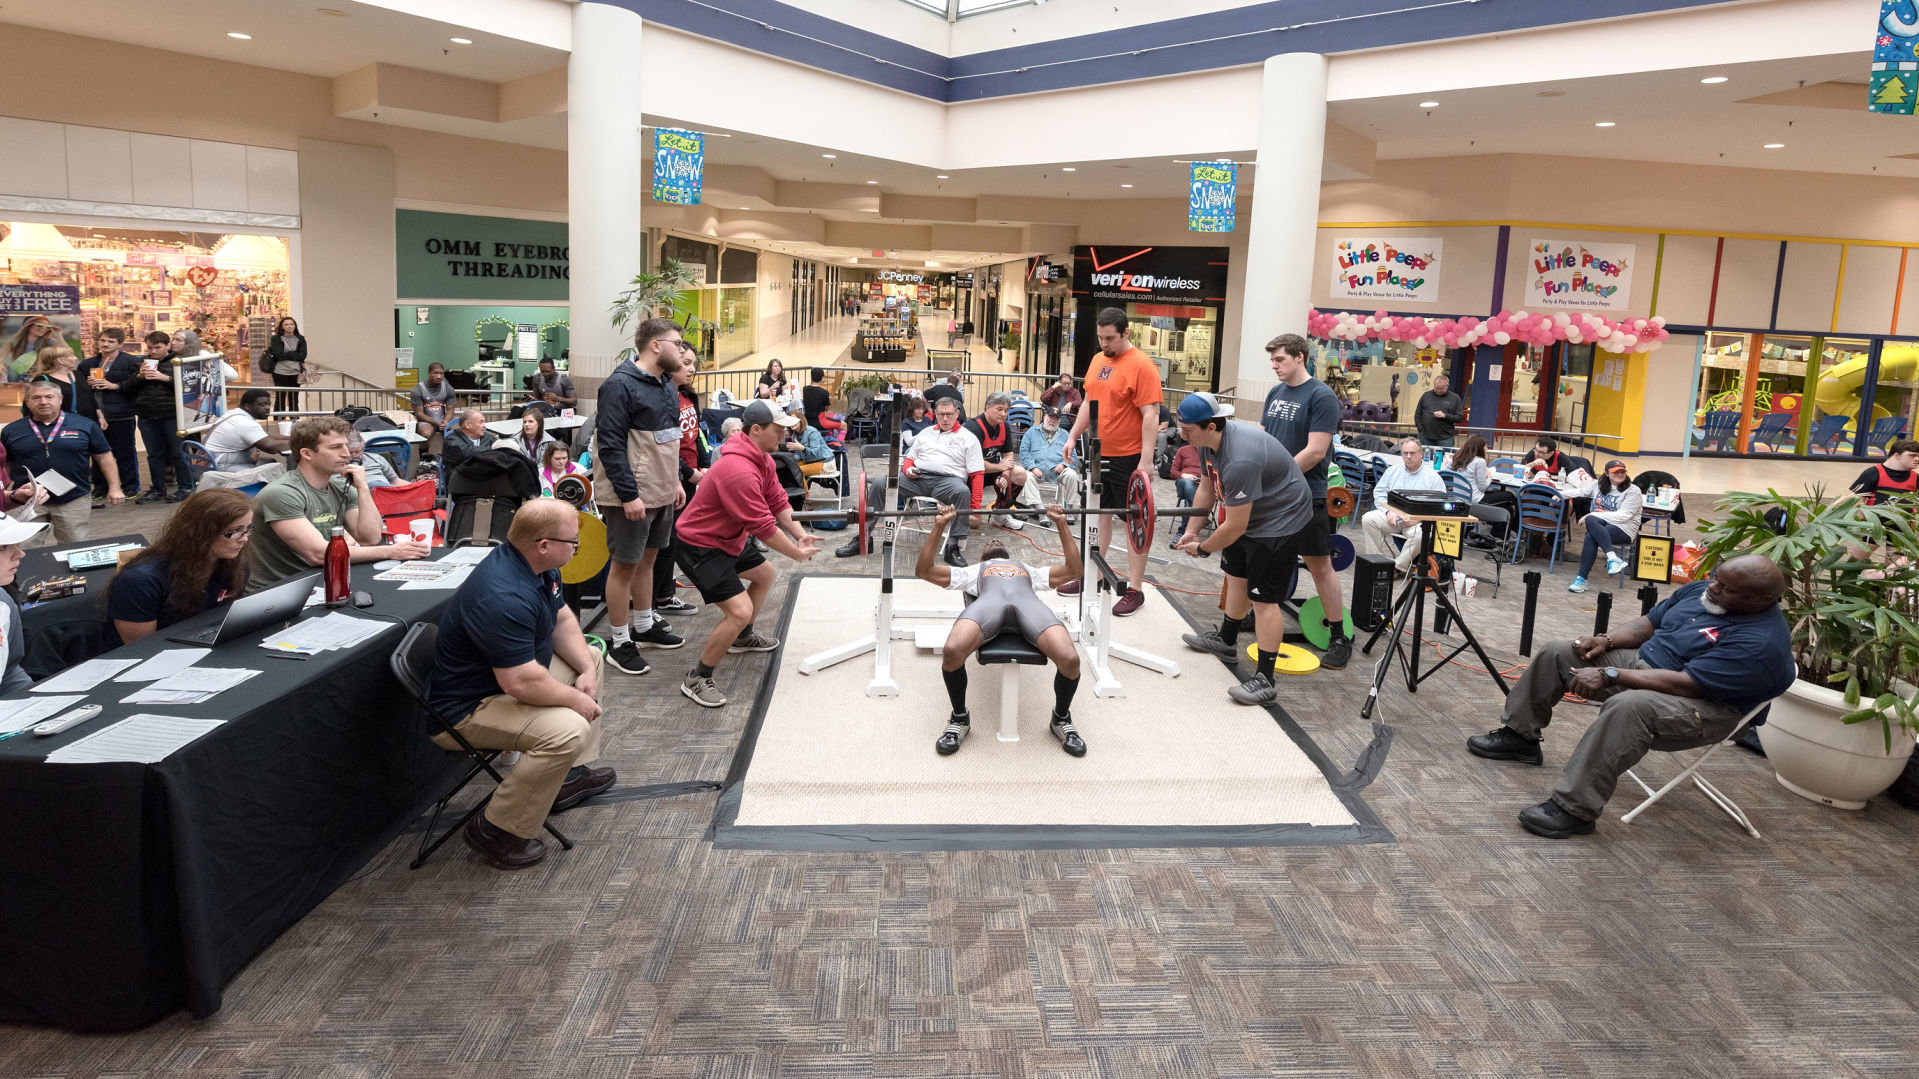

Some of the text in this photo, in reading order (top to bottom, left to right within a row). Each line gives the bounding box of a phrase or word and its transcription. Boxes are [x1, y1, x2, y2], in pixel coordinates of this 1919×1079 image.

[425, 238, 481, 256] OMM
[1338, 248, 1380, 269] Little
[1534, 252, 1576, 274] Little
[190, 267, 215, 285] ty
[877, 271, 924, 283] JCPenney
[1348, 275, 1374, 289] Fun
[1093, 291, 1153, 301] cellularsales.com
[1544, 281, 1569, 296] Fun
[23, 298, 72, 311] FREE
